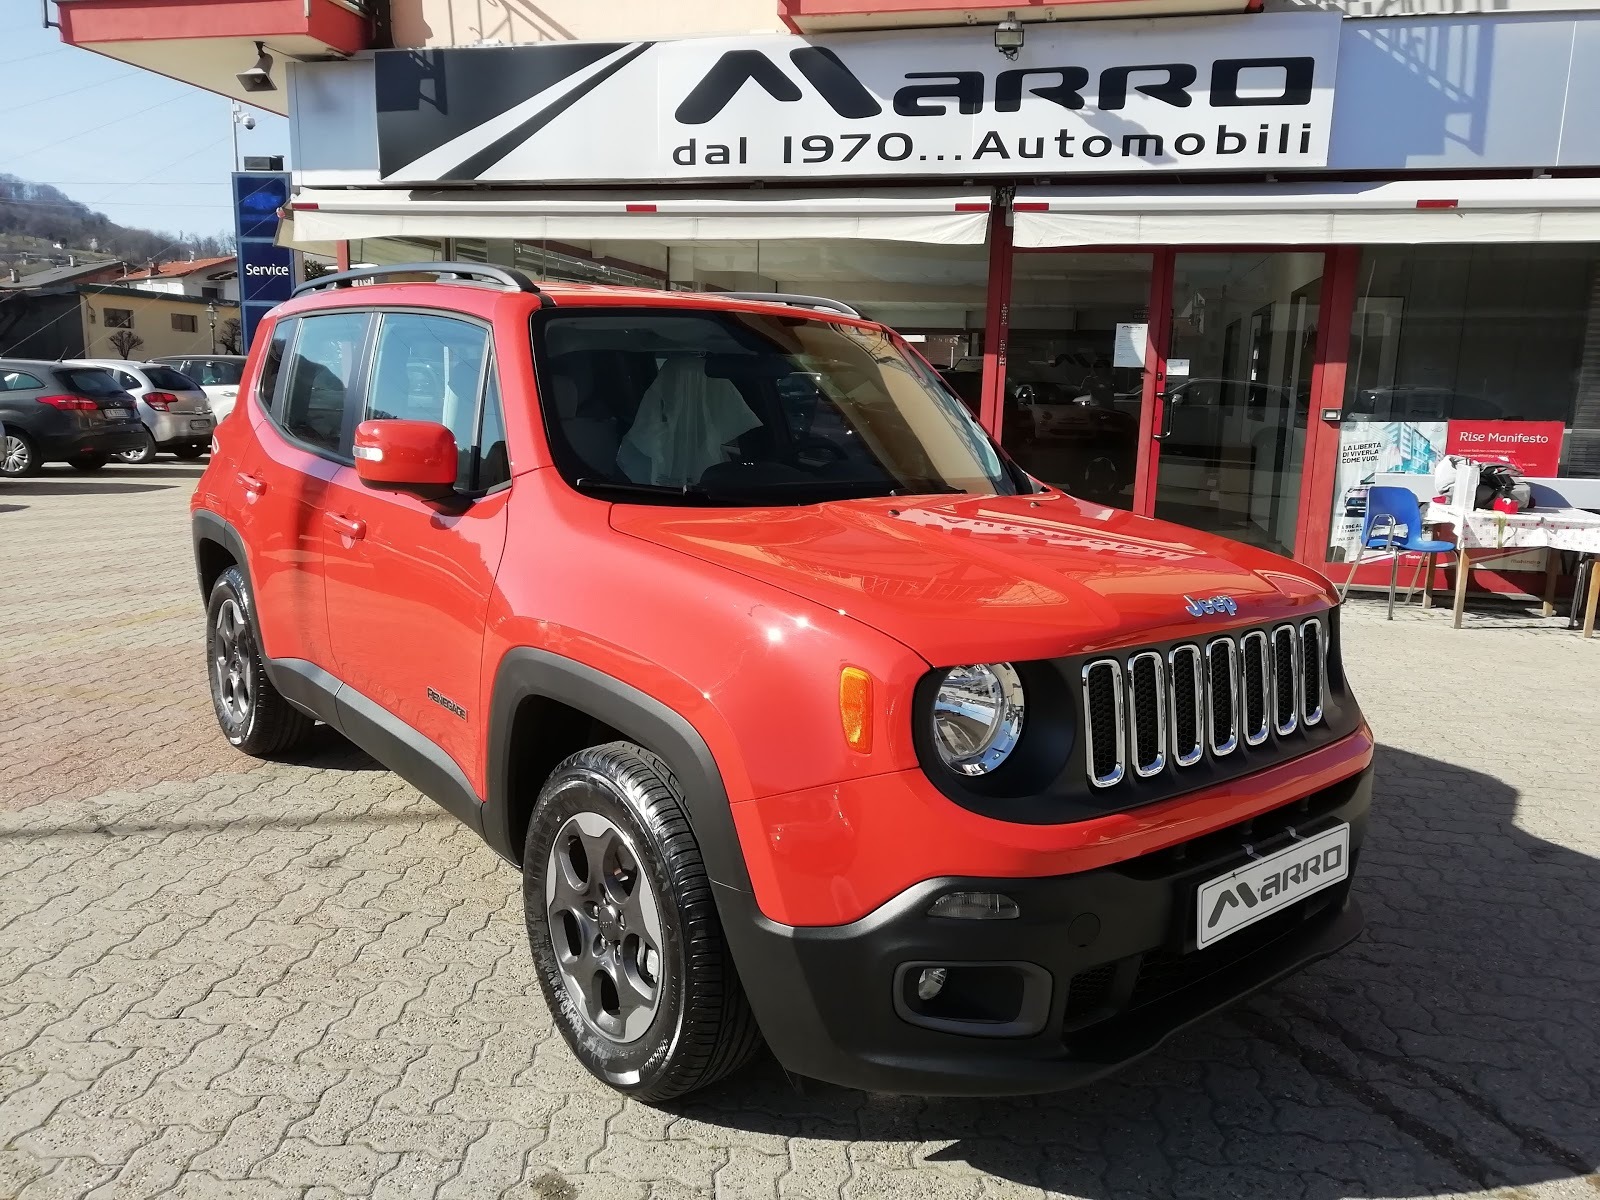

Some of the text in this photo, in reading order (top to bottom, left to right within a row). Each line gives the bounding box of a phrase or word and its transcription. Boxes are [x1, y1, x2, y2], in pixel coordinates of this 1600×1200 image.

[673, 136, 747, 166] dal
[245, 263, 289, 276] Service
[1459, 431, 1549, 443] Rise Manifesto
[1350, 449, 1379, 457] VIVERLA
[1183, 594, 1238, 617] Jeep
[427, 687, 466, 720] RENEGADE
